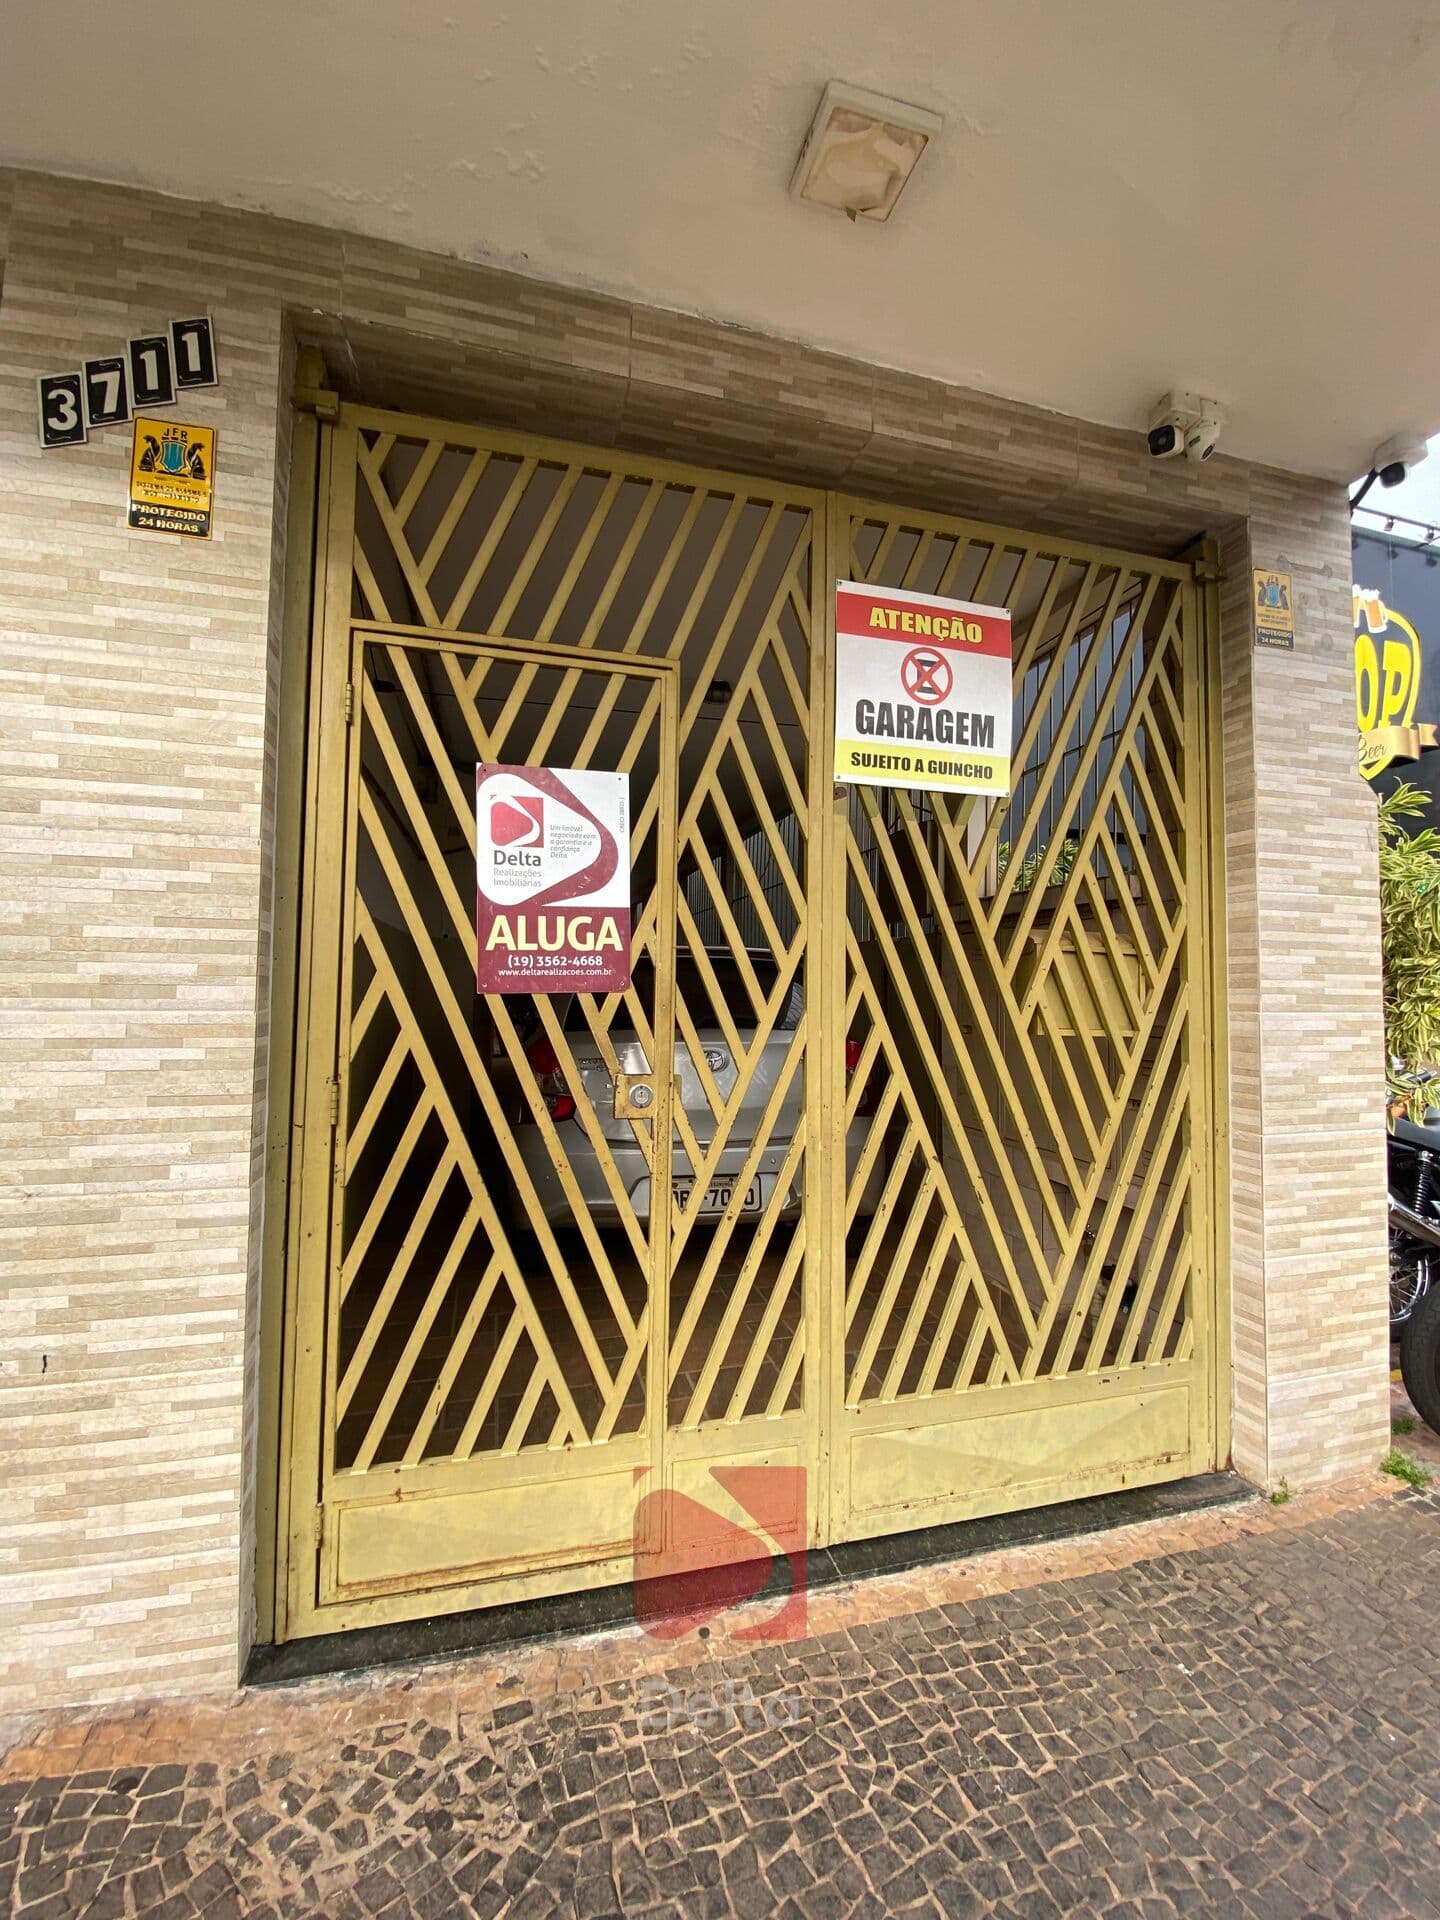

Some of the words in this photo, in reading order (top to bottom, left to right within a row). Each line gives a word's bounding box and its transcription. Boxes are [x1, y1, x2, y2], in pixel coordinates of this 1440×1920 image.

[47, 331, 201, 431] 3711
[163, 427, 188, 441] JFR
[131, 503, 206, 521] PROTEGIDO
[138, 516, 154, 526] 24
[156, 520, 199, 533] HORAS
[868, 607, 983, 644] ATENÇÃO
[855, 698, 995, 749] GARAGEM
[850, 751, 911, 770] SUJEITO
[914, 758, 925, 772] A
[927, 760, 993, 779] GUINCHO
[493, 849, 542, 868] Delta
[493, 867, 542, 879] Realizações
[493, 877, 542, 888] Imobiliárias
[485, 915, 624, 952] ALUGA
[508, 954, 534, 967] (19)
[536, 954, 603, 967] 3562-4668
[498, 967, 612, 977] www.deltarealizacoes.com.br
